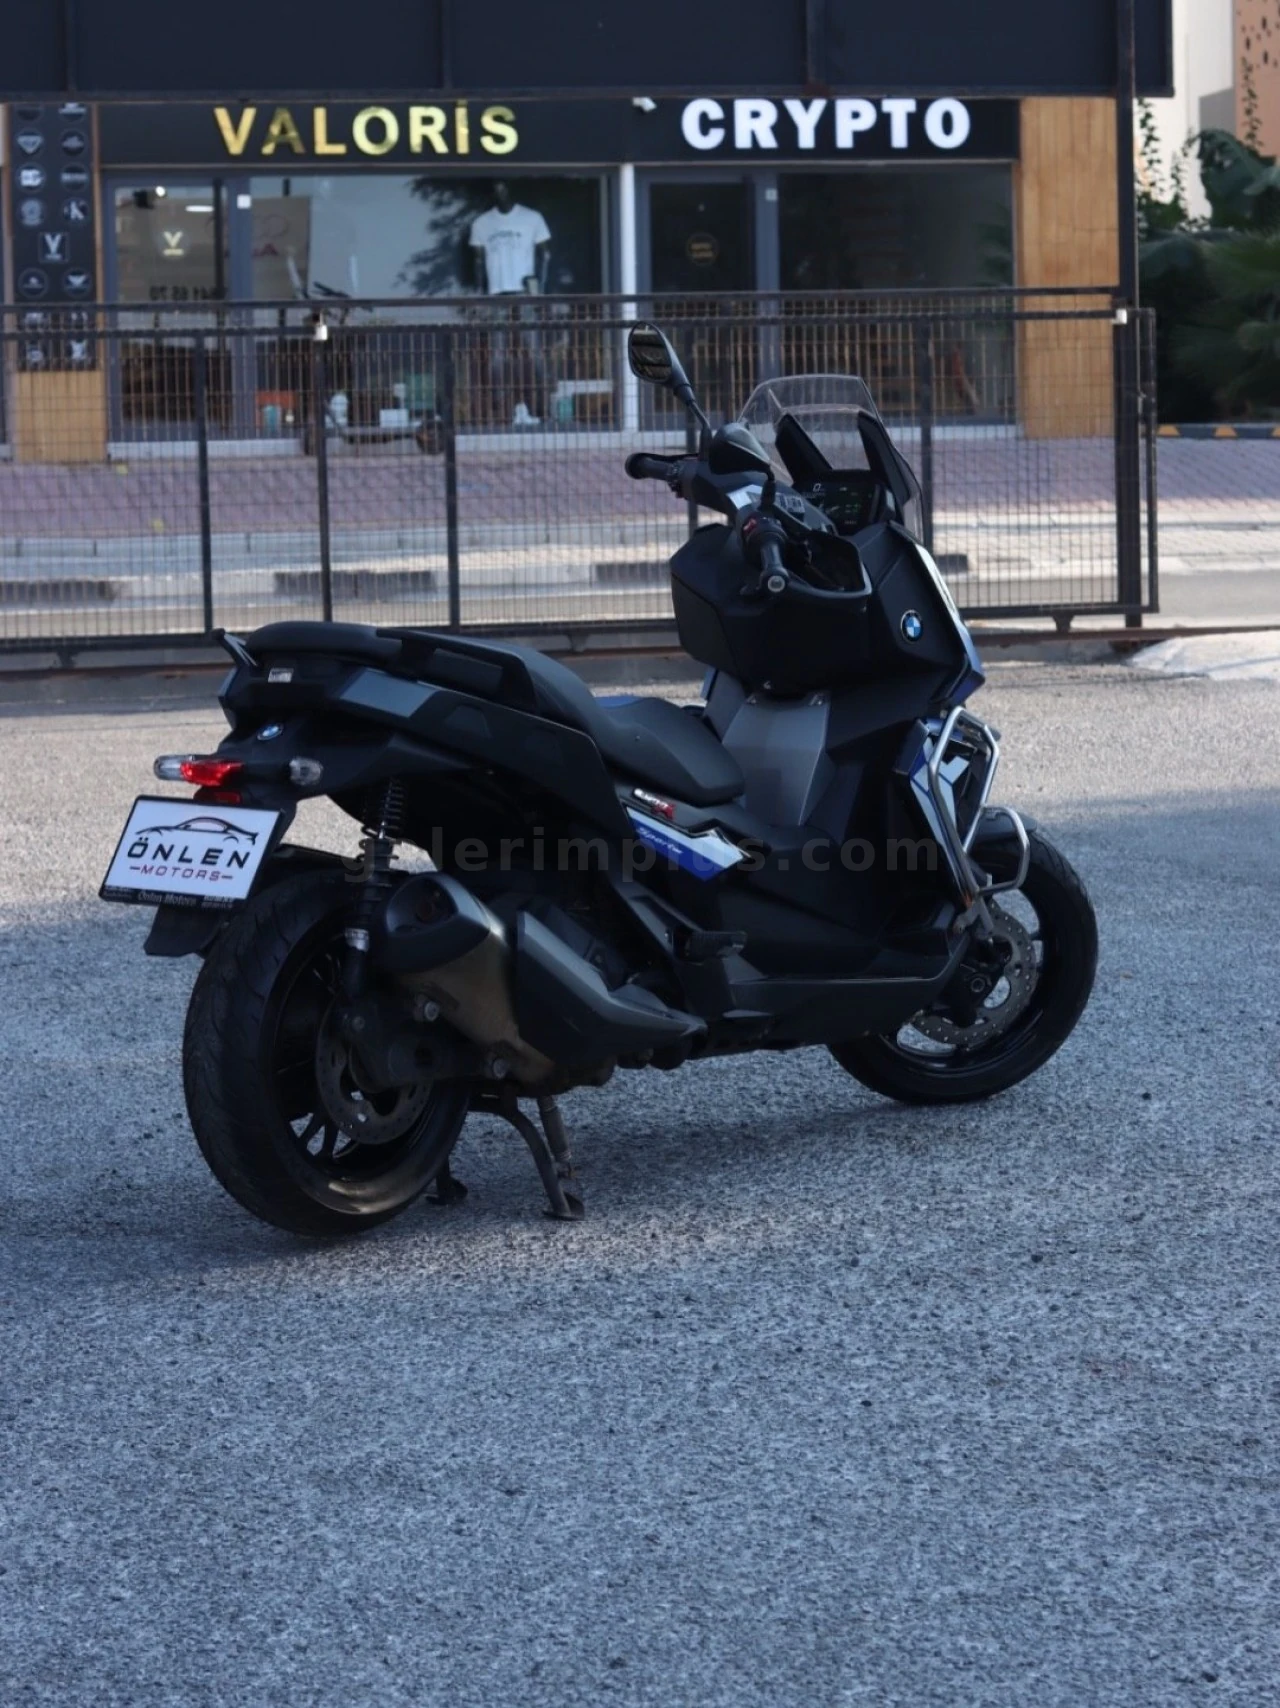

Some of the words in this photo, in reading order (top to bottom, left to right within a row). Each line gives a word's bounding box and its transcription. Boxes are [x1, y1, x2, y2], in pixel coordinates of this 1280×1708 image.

[213, 99, 518, 154] VALORİS
[682, 98, 971, 149] CRYPTO
[127, 836, 250, 869] ÖNLEN
[140, 864, 222, 881] MOTORS
